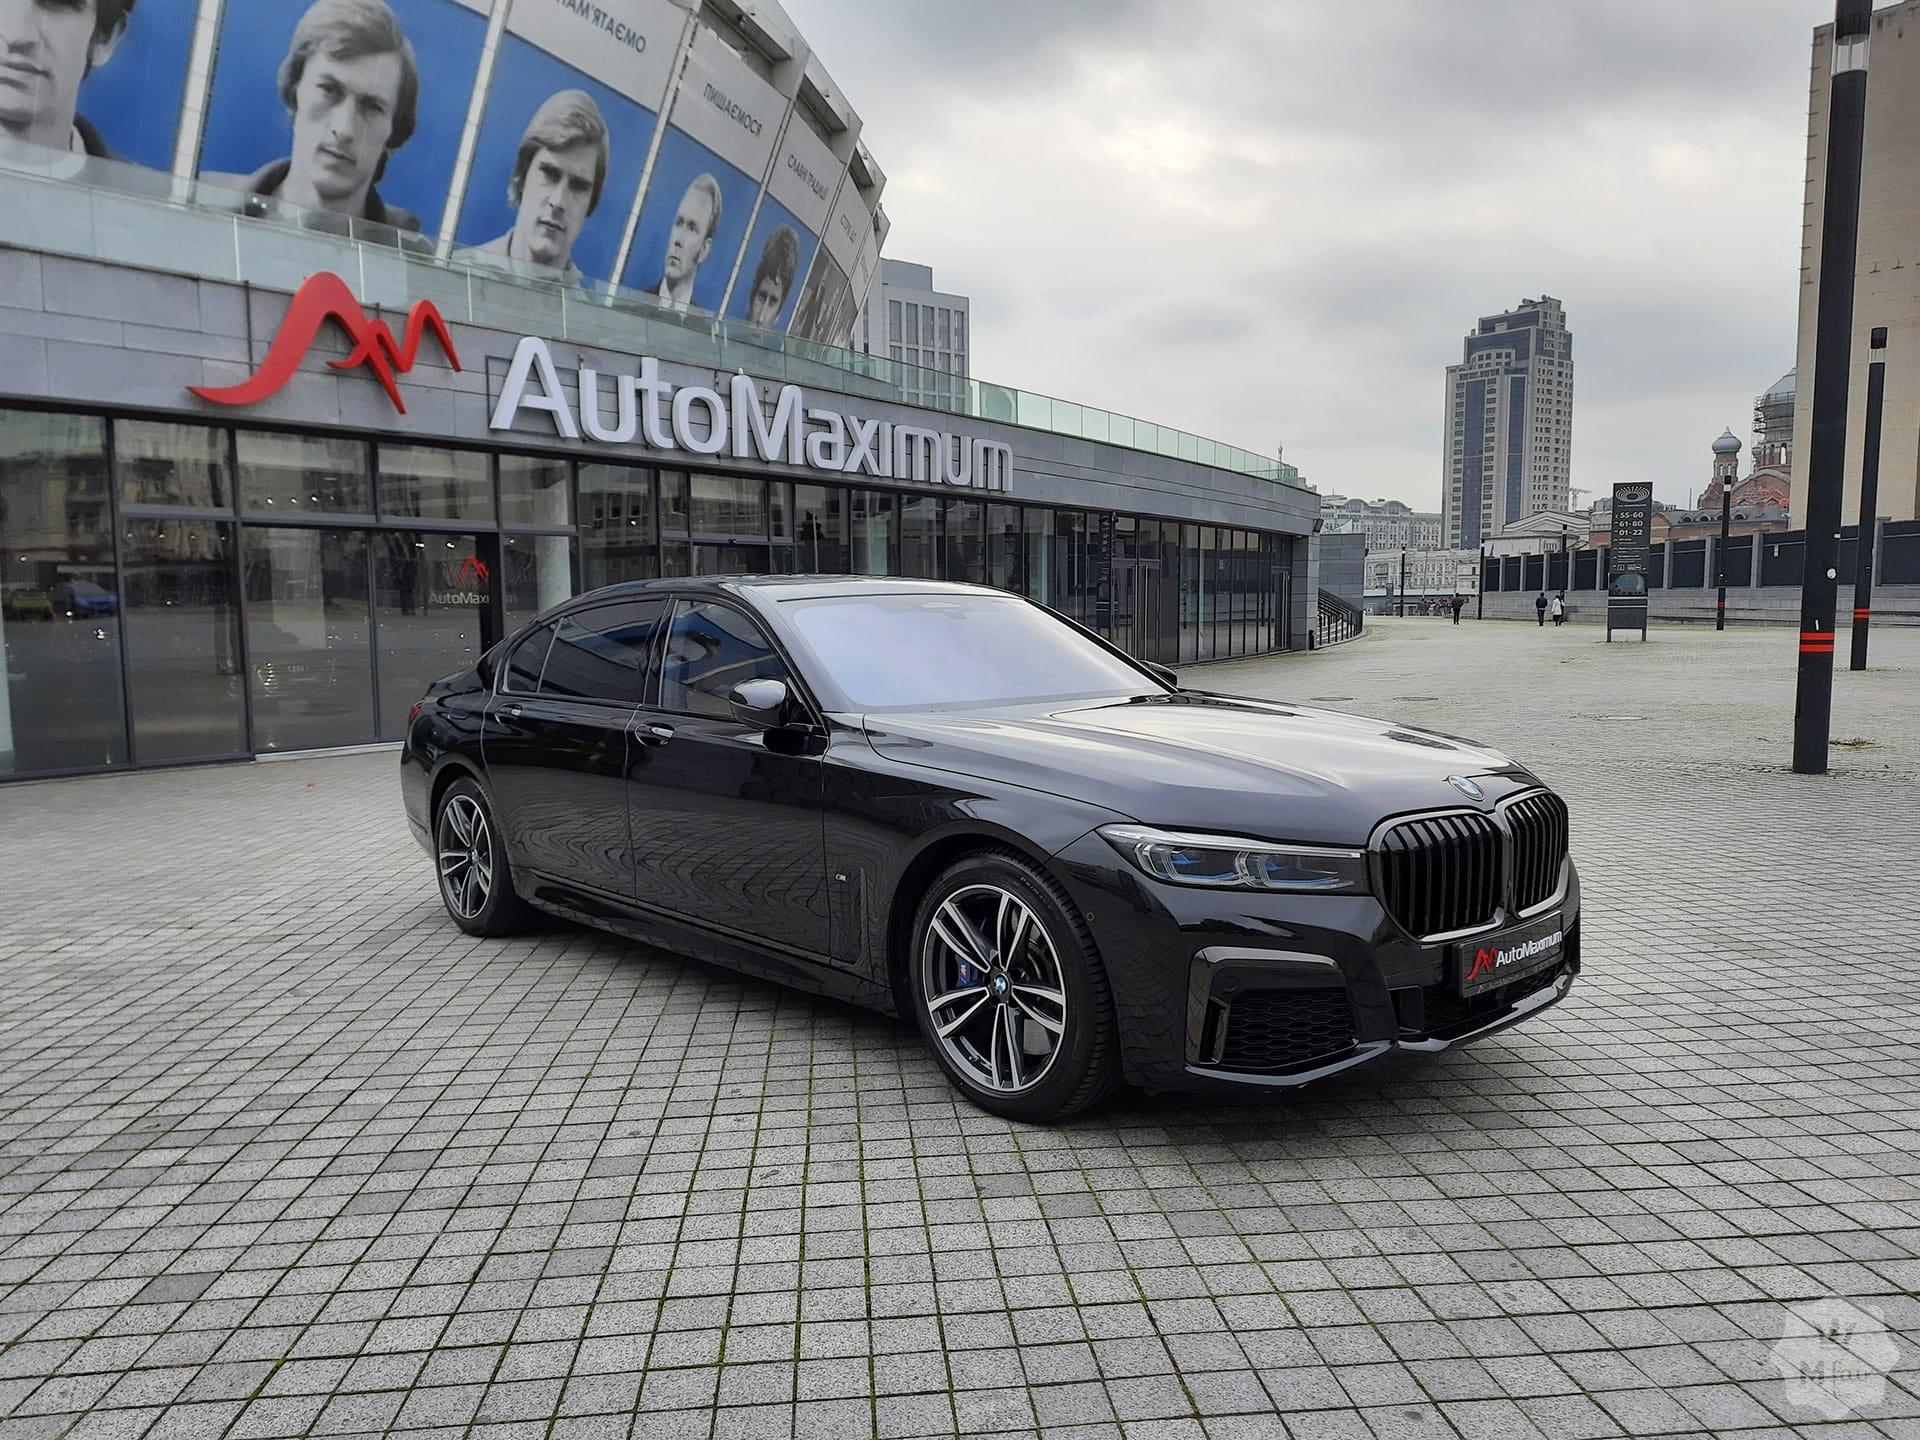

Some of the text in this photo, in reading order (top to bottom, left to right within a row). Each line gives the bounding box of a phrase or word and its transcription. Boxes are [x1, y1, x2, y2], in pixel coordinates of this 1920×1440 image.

[556, 0, 647, 53] АМ'ЯТАЄМО
[703, 82, 762, 138] ПИШАЄМОСЯ
[490, 336, 1013, 492] AutoMaximum
[1619, 511, 1644, 519] 55-60
[1619, 520, 1643, 528] 61-80
[1495, 930, 1562, 968] AutoMaximum
